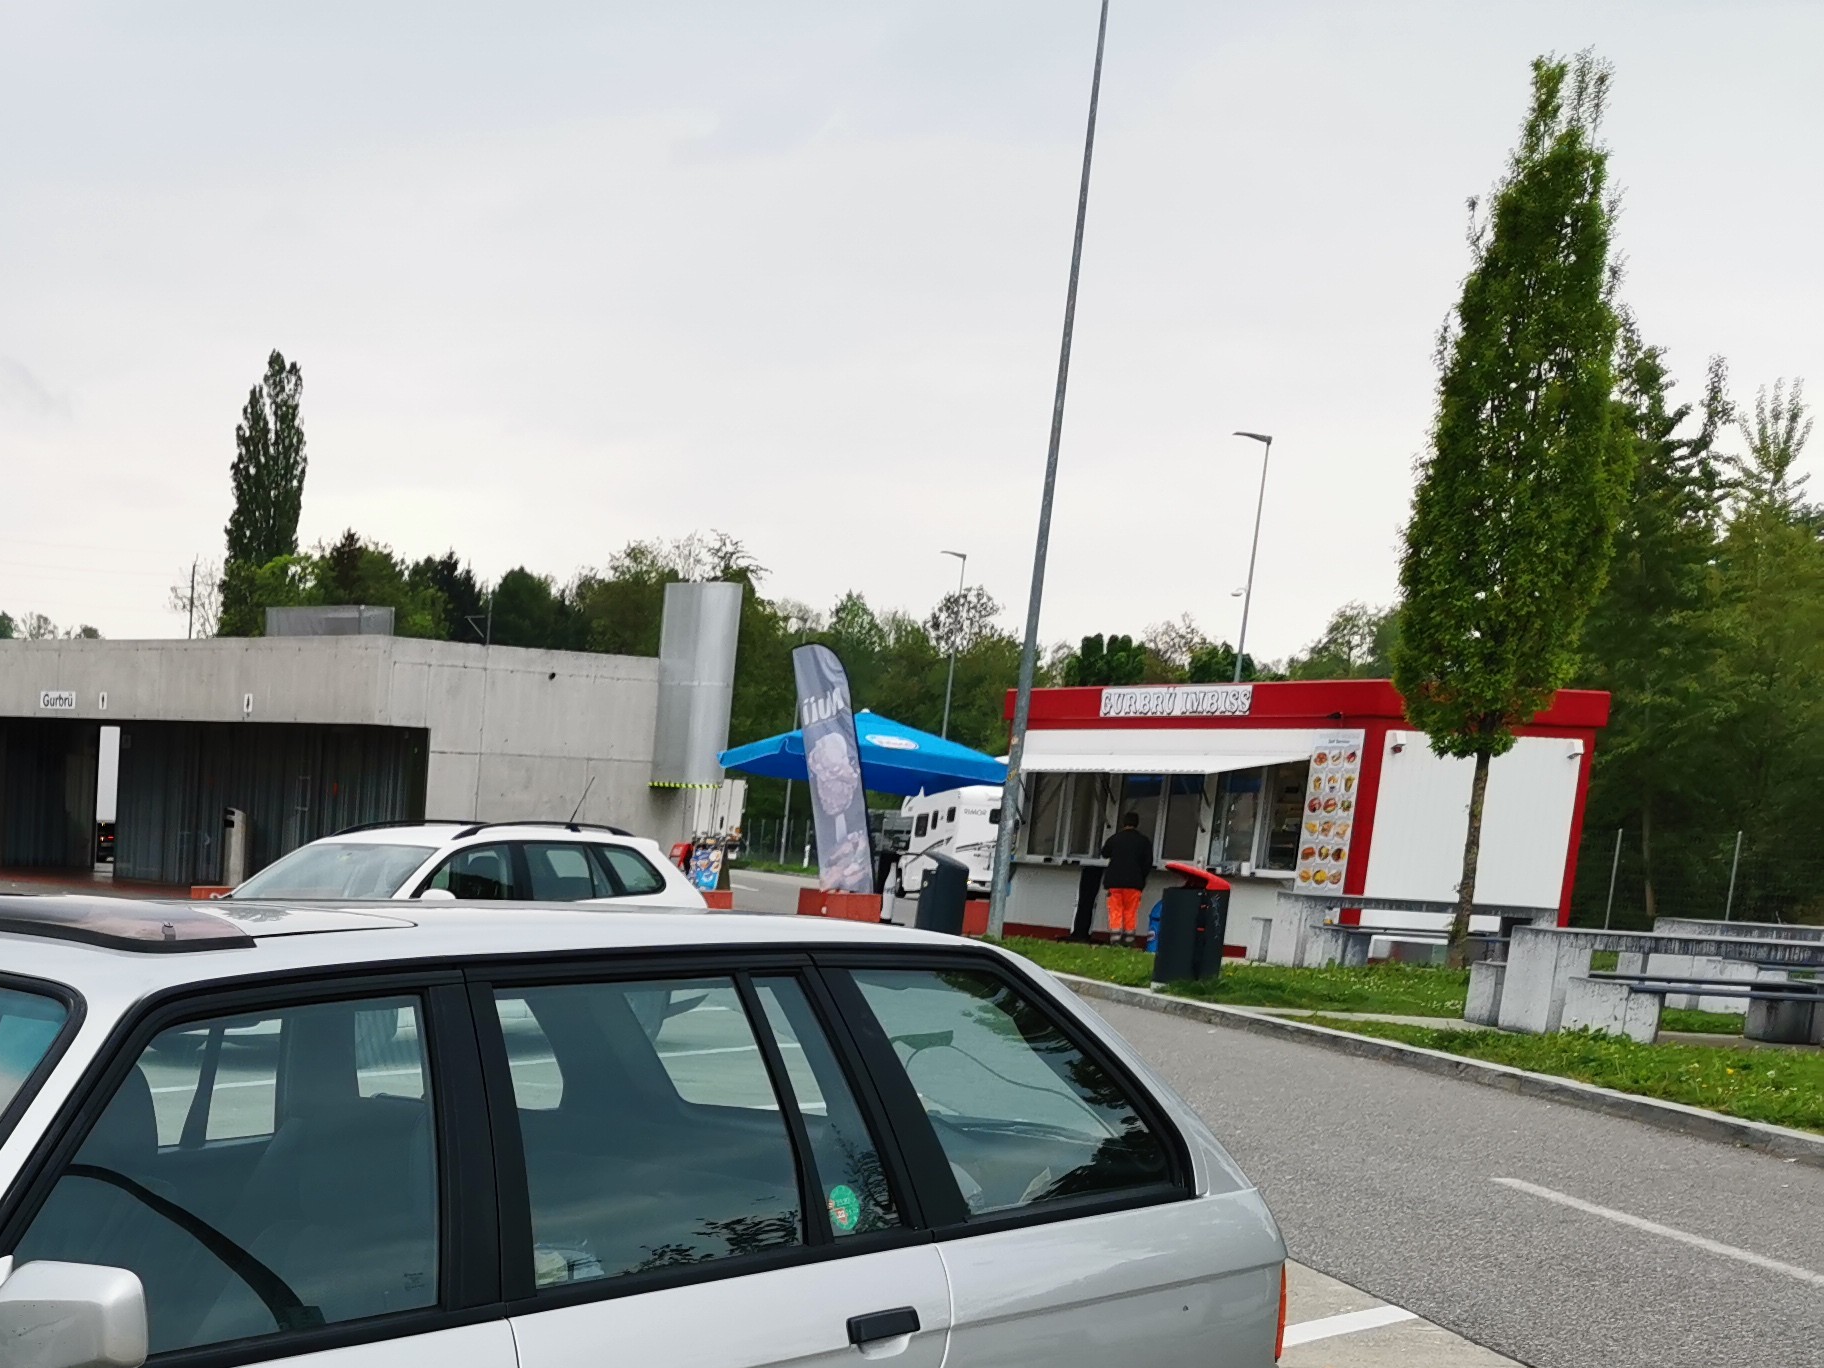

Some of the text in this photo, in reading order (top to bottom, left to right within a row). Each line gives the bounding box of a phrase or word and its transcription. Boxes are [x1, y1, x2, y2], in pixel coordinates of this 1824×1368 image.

[42, 693, 73, 708] Gurbrü
[1101, 686, 1251, 715] GURBRÜ IMBISS
